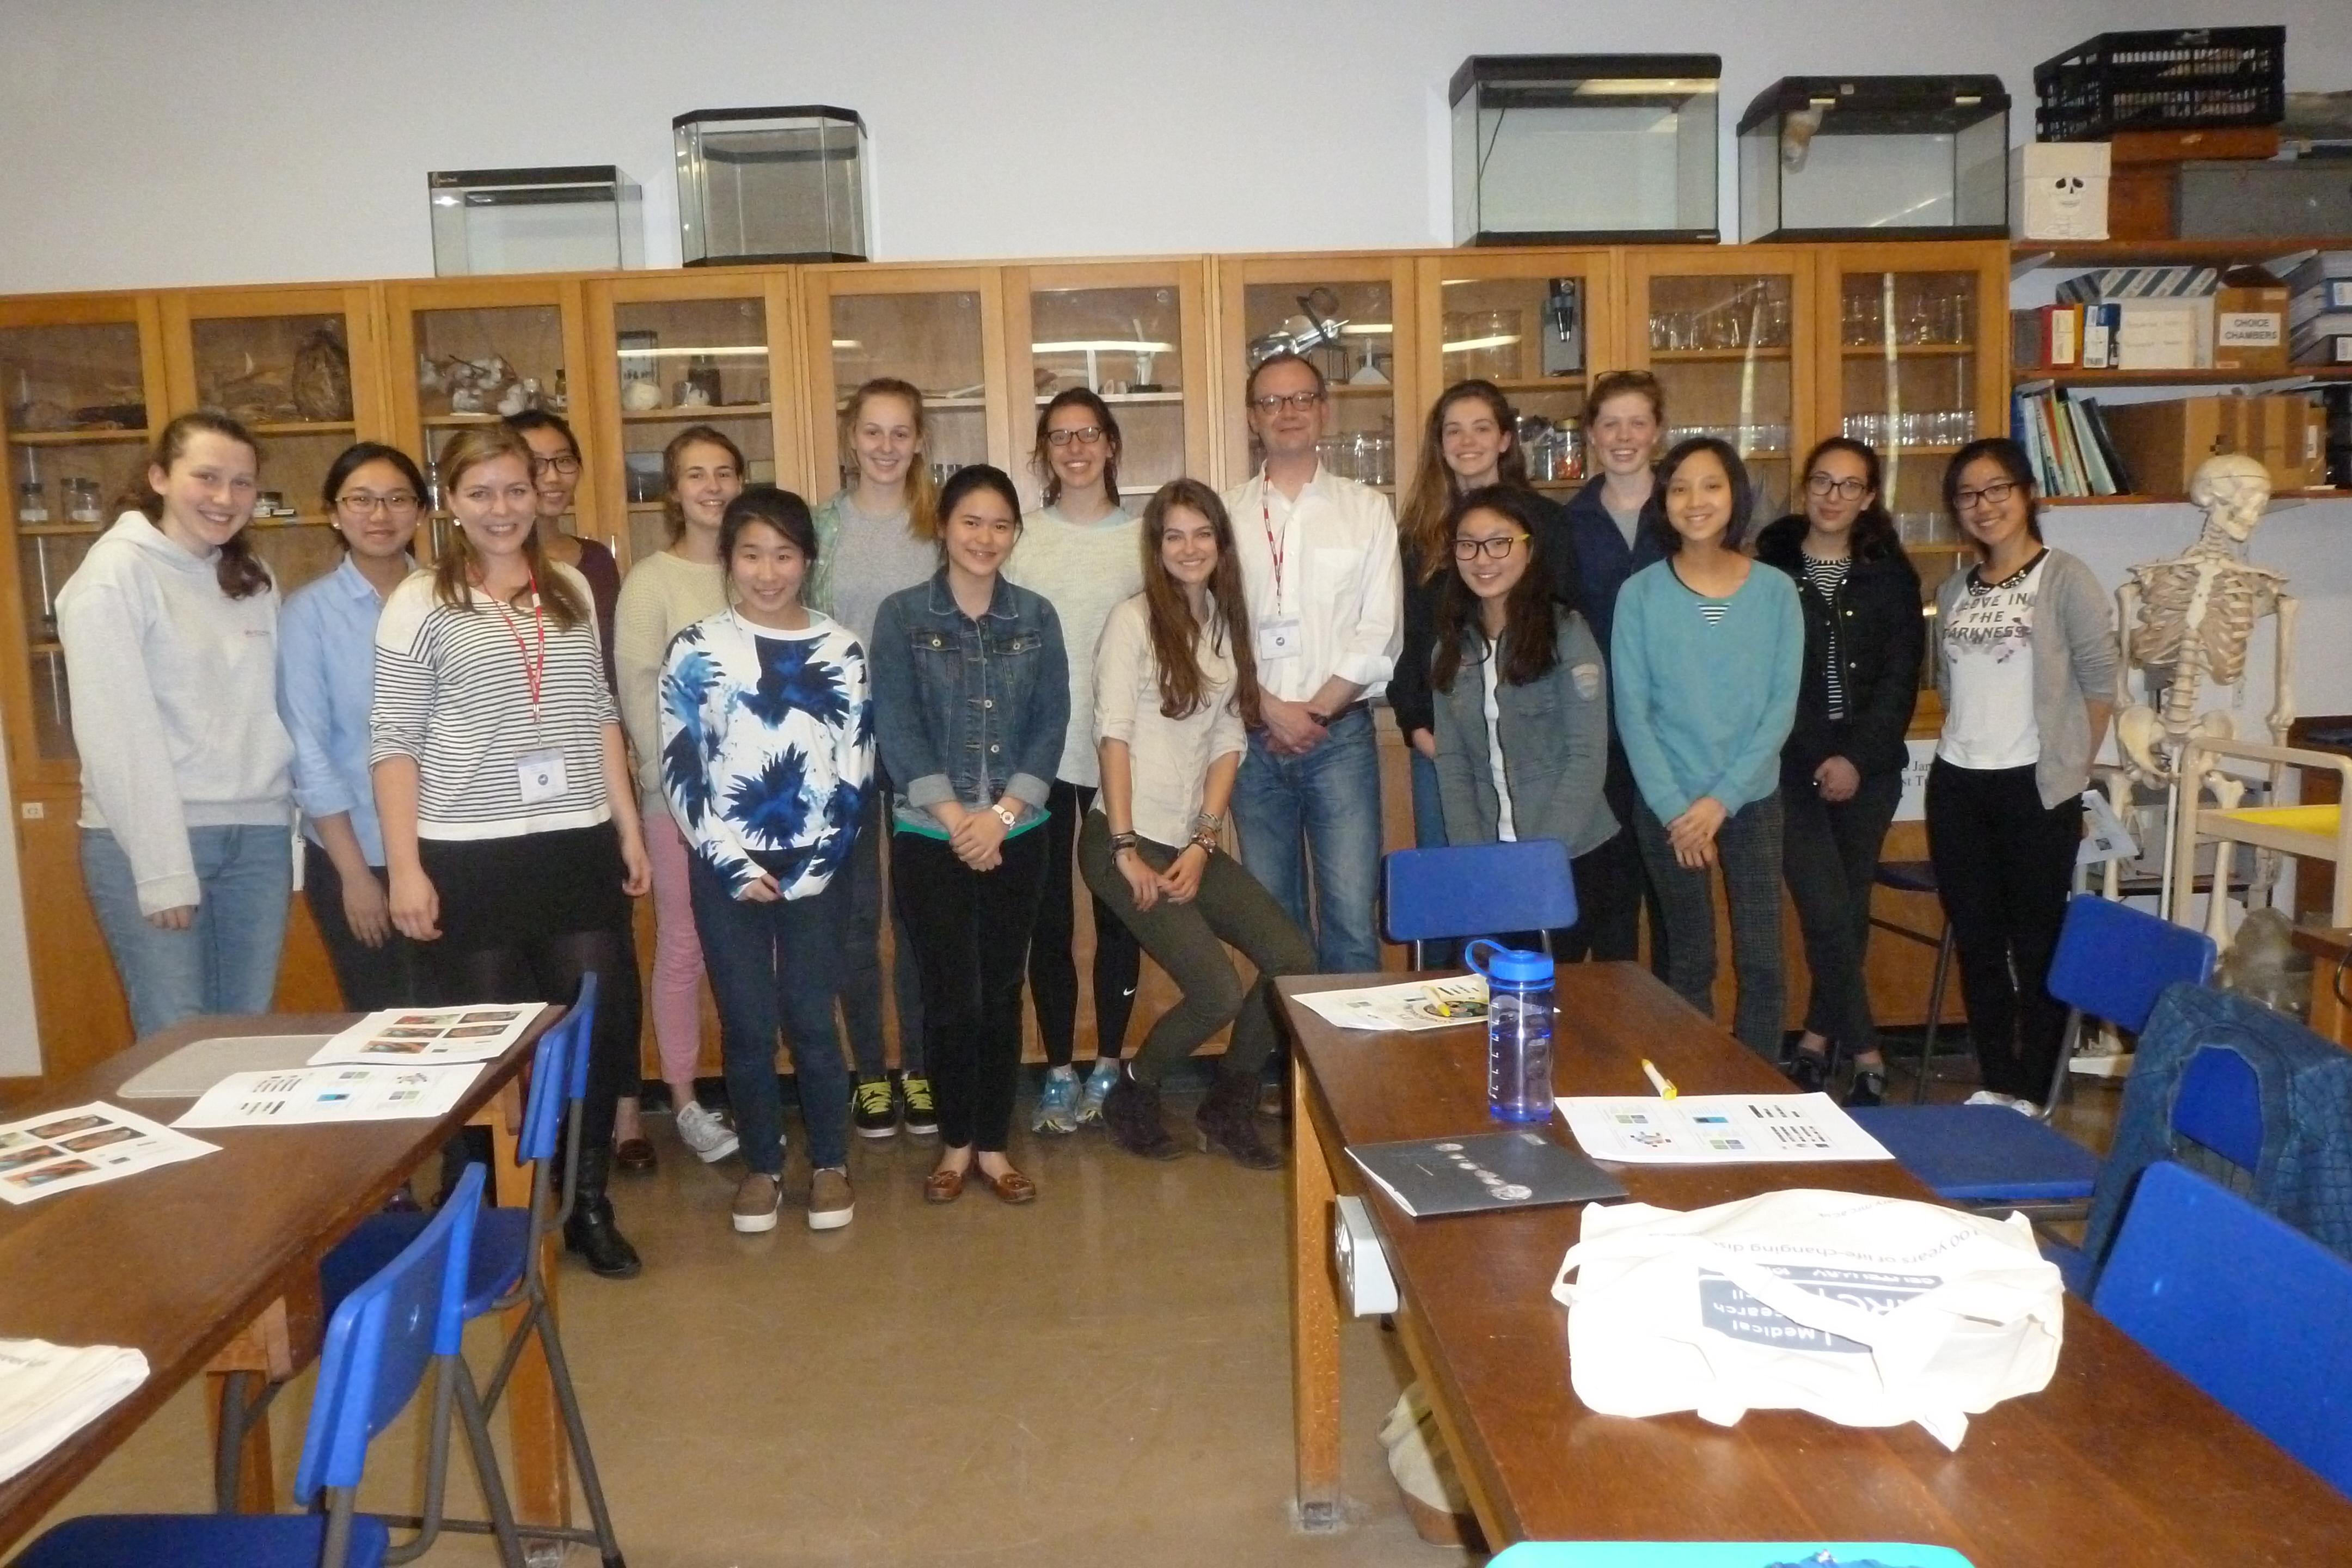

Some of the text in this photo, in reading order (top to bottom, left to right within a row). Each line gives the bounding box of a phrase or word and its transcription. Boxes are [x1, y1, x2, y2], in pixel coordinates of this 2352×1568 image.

[2234, 318, 2270, 328] CHOICE
[2225, 330, 2278, 340] CHAMBERS
[1961, 592, 2029, 611] LOVE IN
[1969, 611, 2005, 623] THE
[1750, 1244, 1873, 1262] life-changing
[1879, 1255, 1897, 1264] of
[1902, 1240, 1947, 1264] years
[1732, 1320, 1815, 1340] Medical
